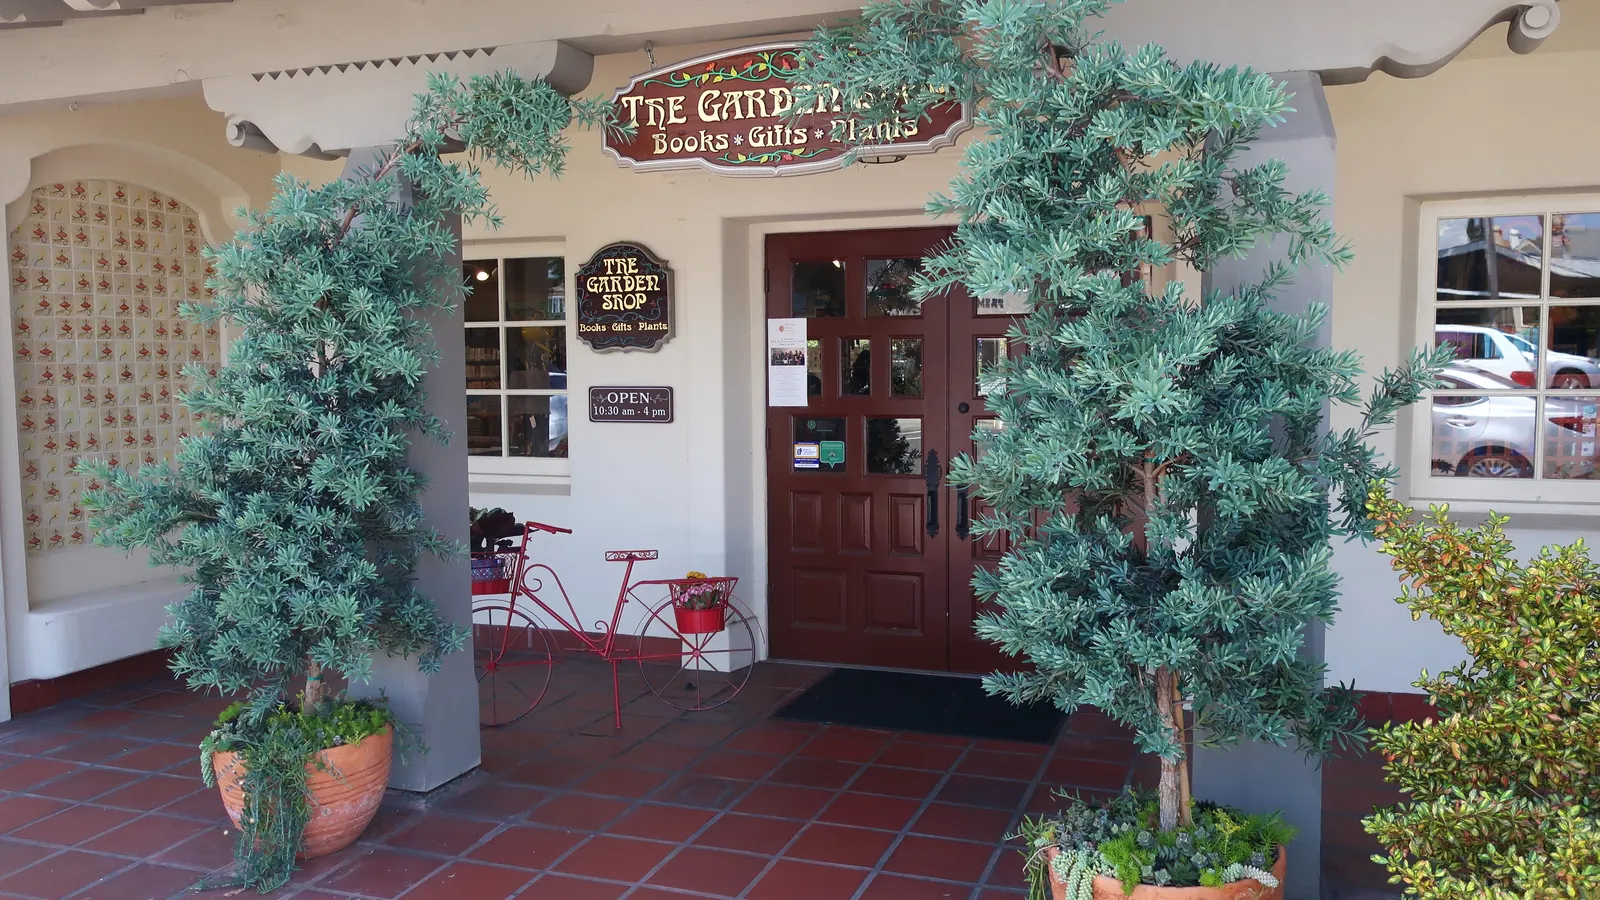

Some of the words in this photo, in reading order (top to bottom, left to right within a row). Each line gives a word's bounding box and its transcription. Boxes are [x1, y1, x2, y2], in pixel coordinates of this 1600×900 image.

[621, 95, 688, 131] THE
[652, 130, 729, 155] Books
[748, 125, 808, 148] Gifts
[603, 257, 639, 275] THE
[586, 275, 661, 293] GARDEN
[602, 293, 647, 311] SHOP
[579, 323, 607, 332] Books
[611, 322, 632, 331] Gifts
[638, 321, 668, 331] Plants
[607, 392, 650, 404] OPEN
[593, 406, 619, 416] 10:30
[643, 406, 649, 416] 4
[652, 409, 666, 418] pm
